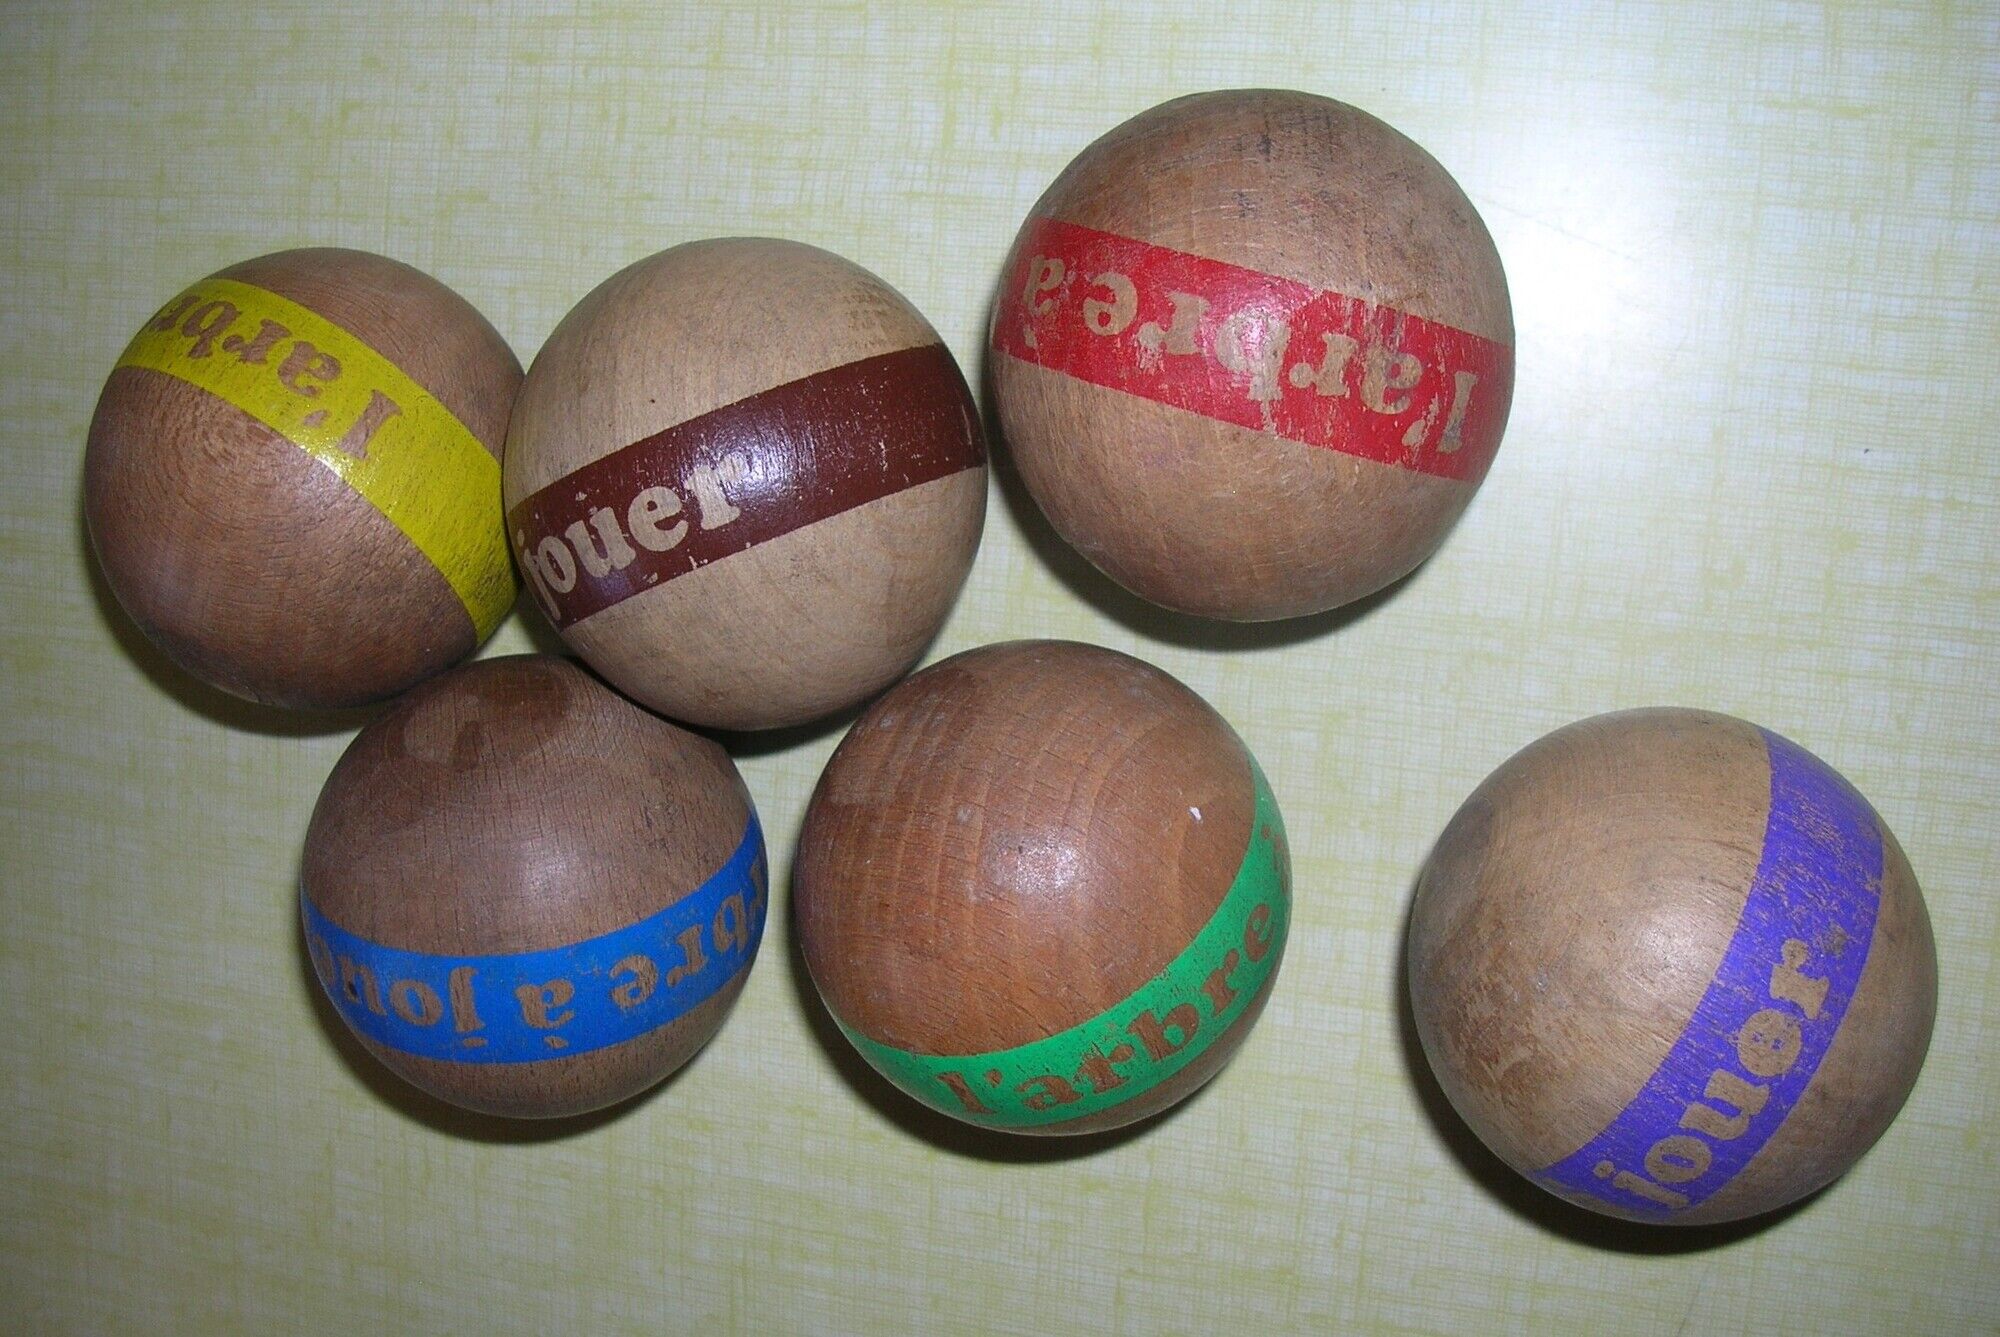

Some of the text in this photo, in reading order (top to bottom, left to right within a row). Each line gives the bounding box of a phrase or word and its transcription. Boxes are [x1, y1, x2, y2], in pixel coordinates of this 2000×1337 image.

[1083, 271, 1478, 453] l'arbre
[517, 452, 750, 620] jouer
[516, 979, 576, 1049] à
[937, 903, 1274, 1115] l'arbre
[1594, 938, 1830, 1209] jouer
